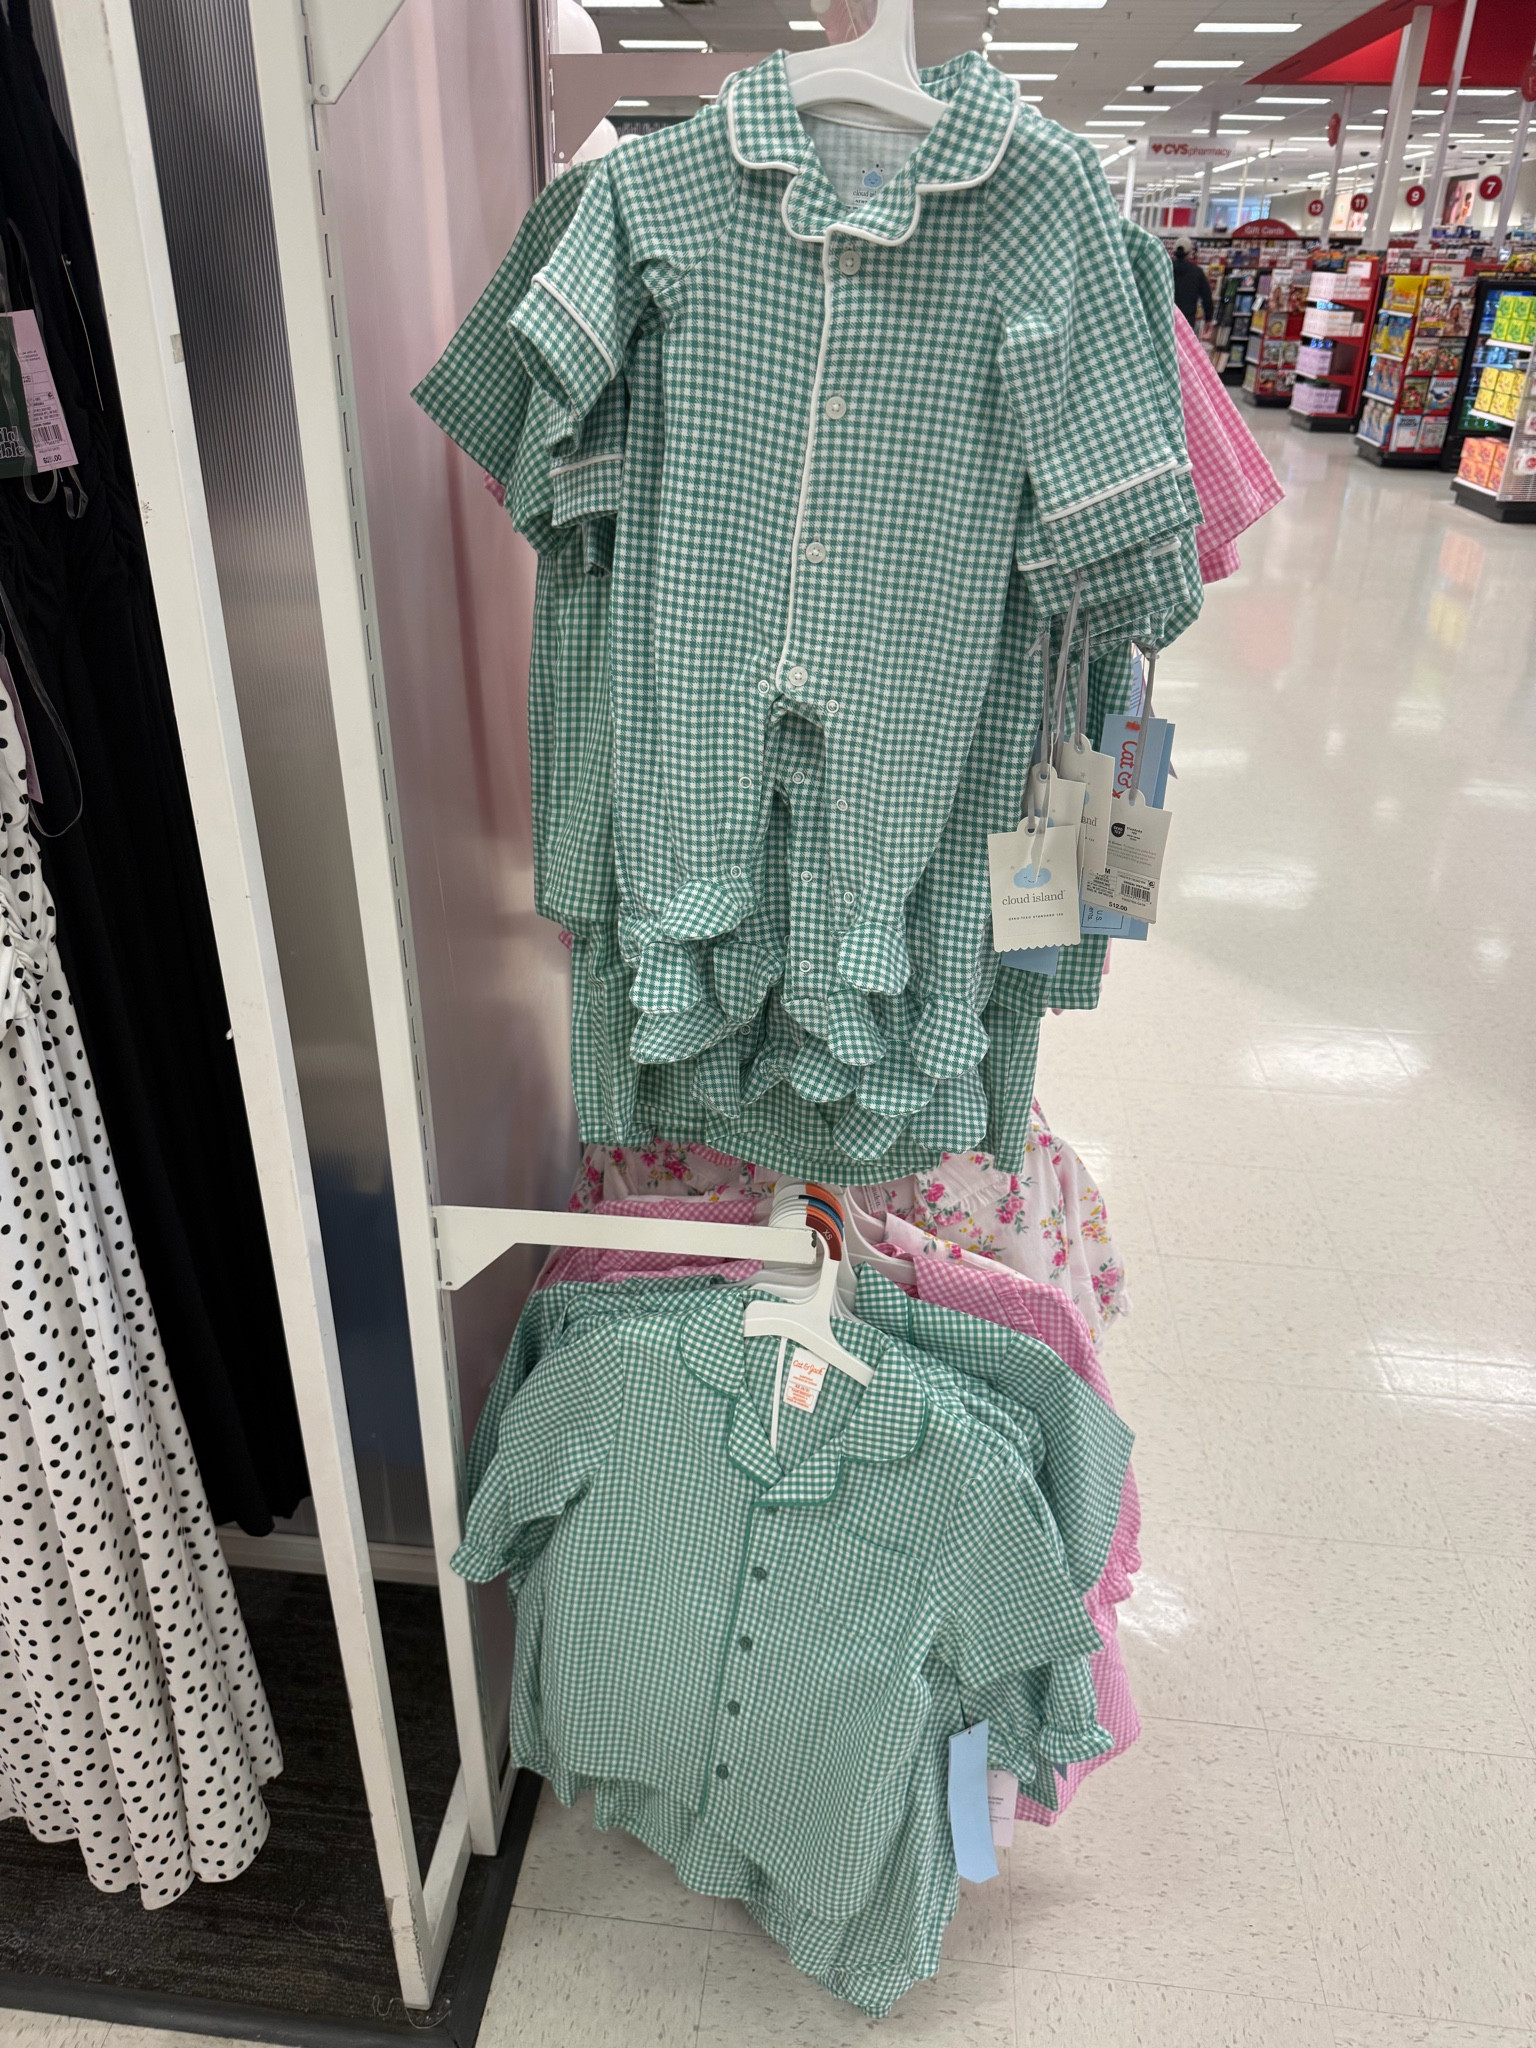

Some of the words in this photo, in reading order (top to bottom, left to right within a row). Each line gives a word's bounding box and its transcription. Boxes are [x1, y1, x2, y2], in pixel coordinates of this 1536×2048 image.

[1163, 143, 1188, 155] CVS
[1487, 181, 1496, 194] 7
[1411, 191, 1420, 202] 9
[1354, 198, 1366, 209] 11
[0, 425, 19, 442] ild
[1001, 893, 1030, 906] cloud
[1032, 889, 1064, 903] island
[1108, 901, 1128, 911] $12.00
[822, 1229, 832, 1240] XS
